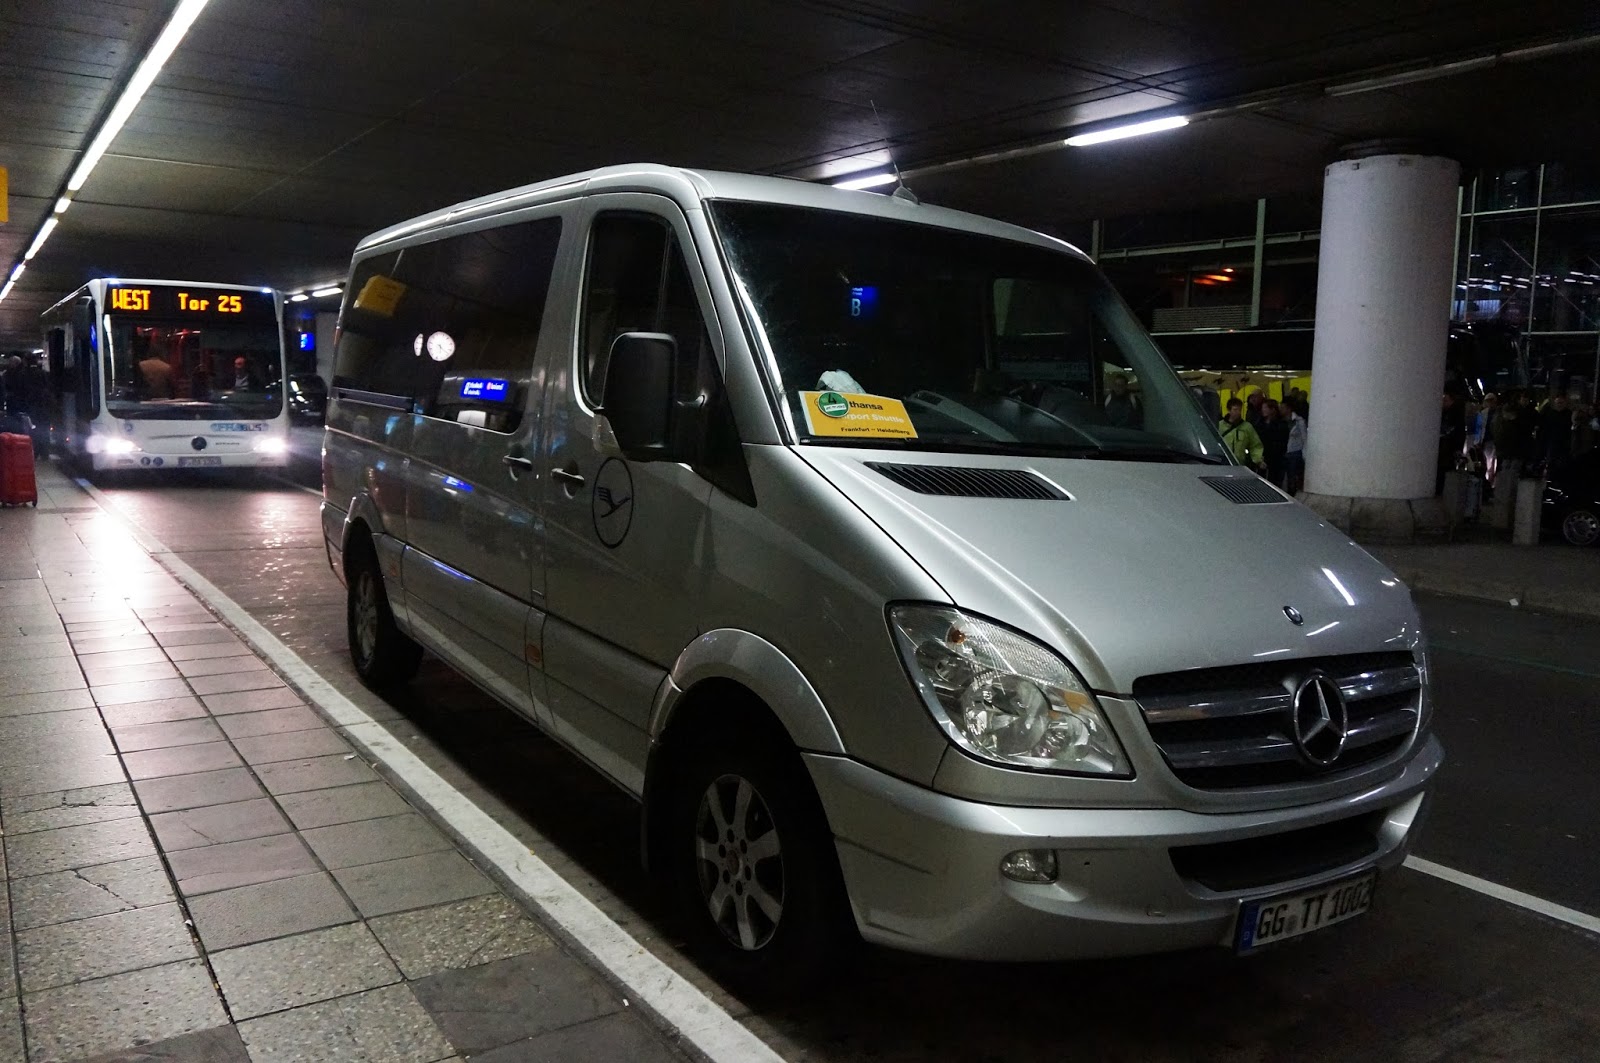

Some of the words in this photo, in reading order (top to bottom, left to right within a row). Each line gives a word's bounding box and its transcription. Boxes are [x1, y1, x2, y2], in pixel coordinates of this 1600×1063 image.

[112, 288, 151, 311] WEST
[177, 292, 209, 311] Tor
[217, 295, 242, 313] 25
[851, 297, 861, 317] B
[828, 392, 837, 404] 4
[849, 400, 883, 410] thansa
[844, 412, 870, 420] irport
[871, 413, 904, 423] Shuttle
[877, 427, 910, 435] Heidelberg
[1257, 904, 1287, 939] GG
[1302, 894, 1327, 928] TT
